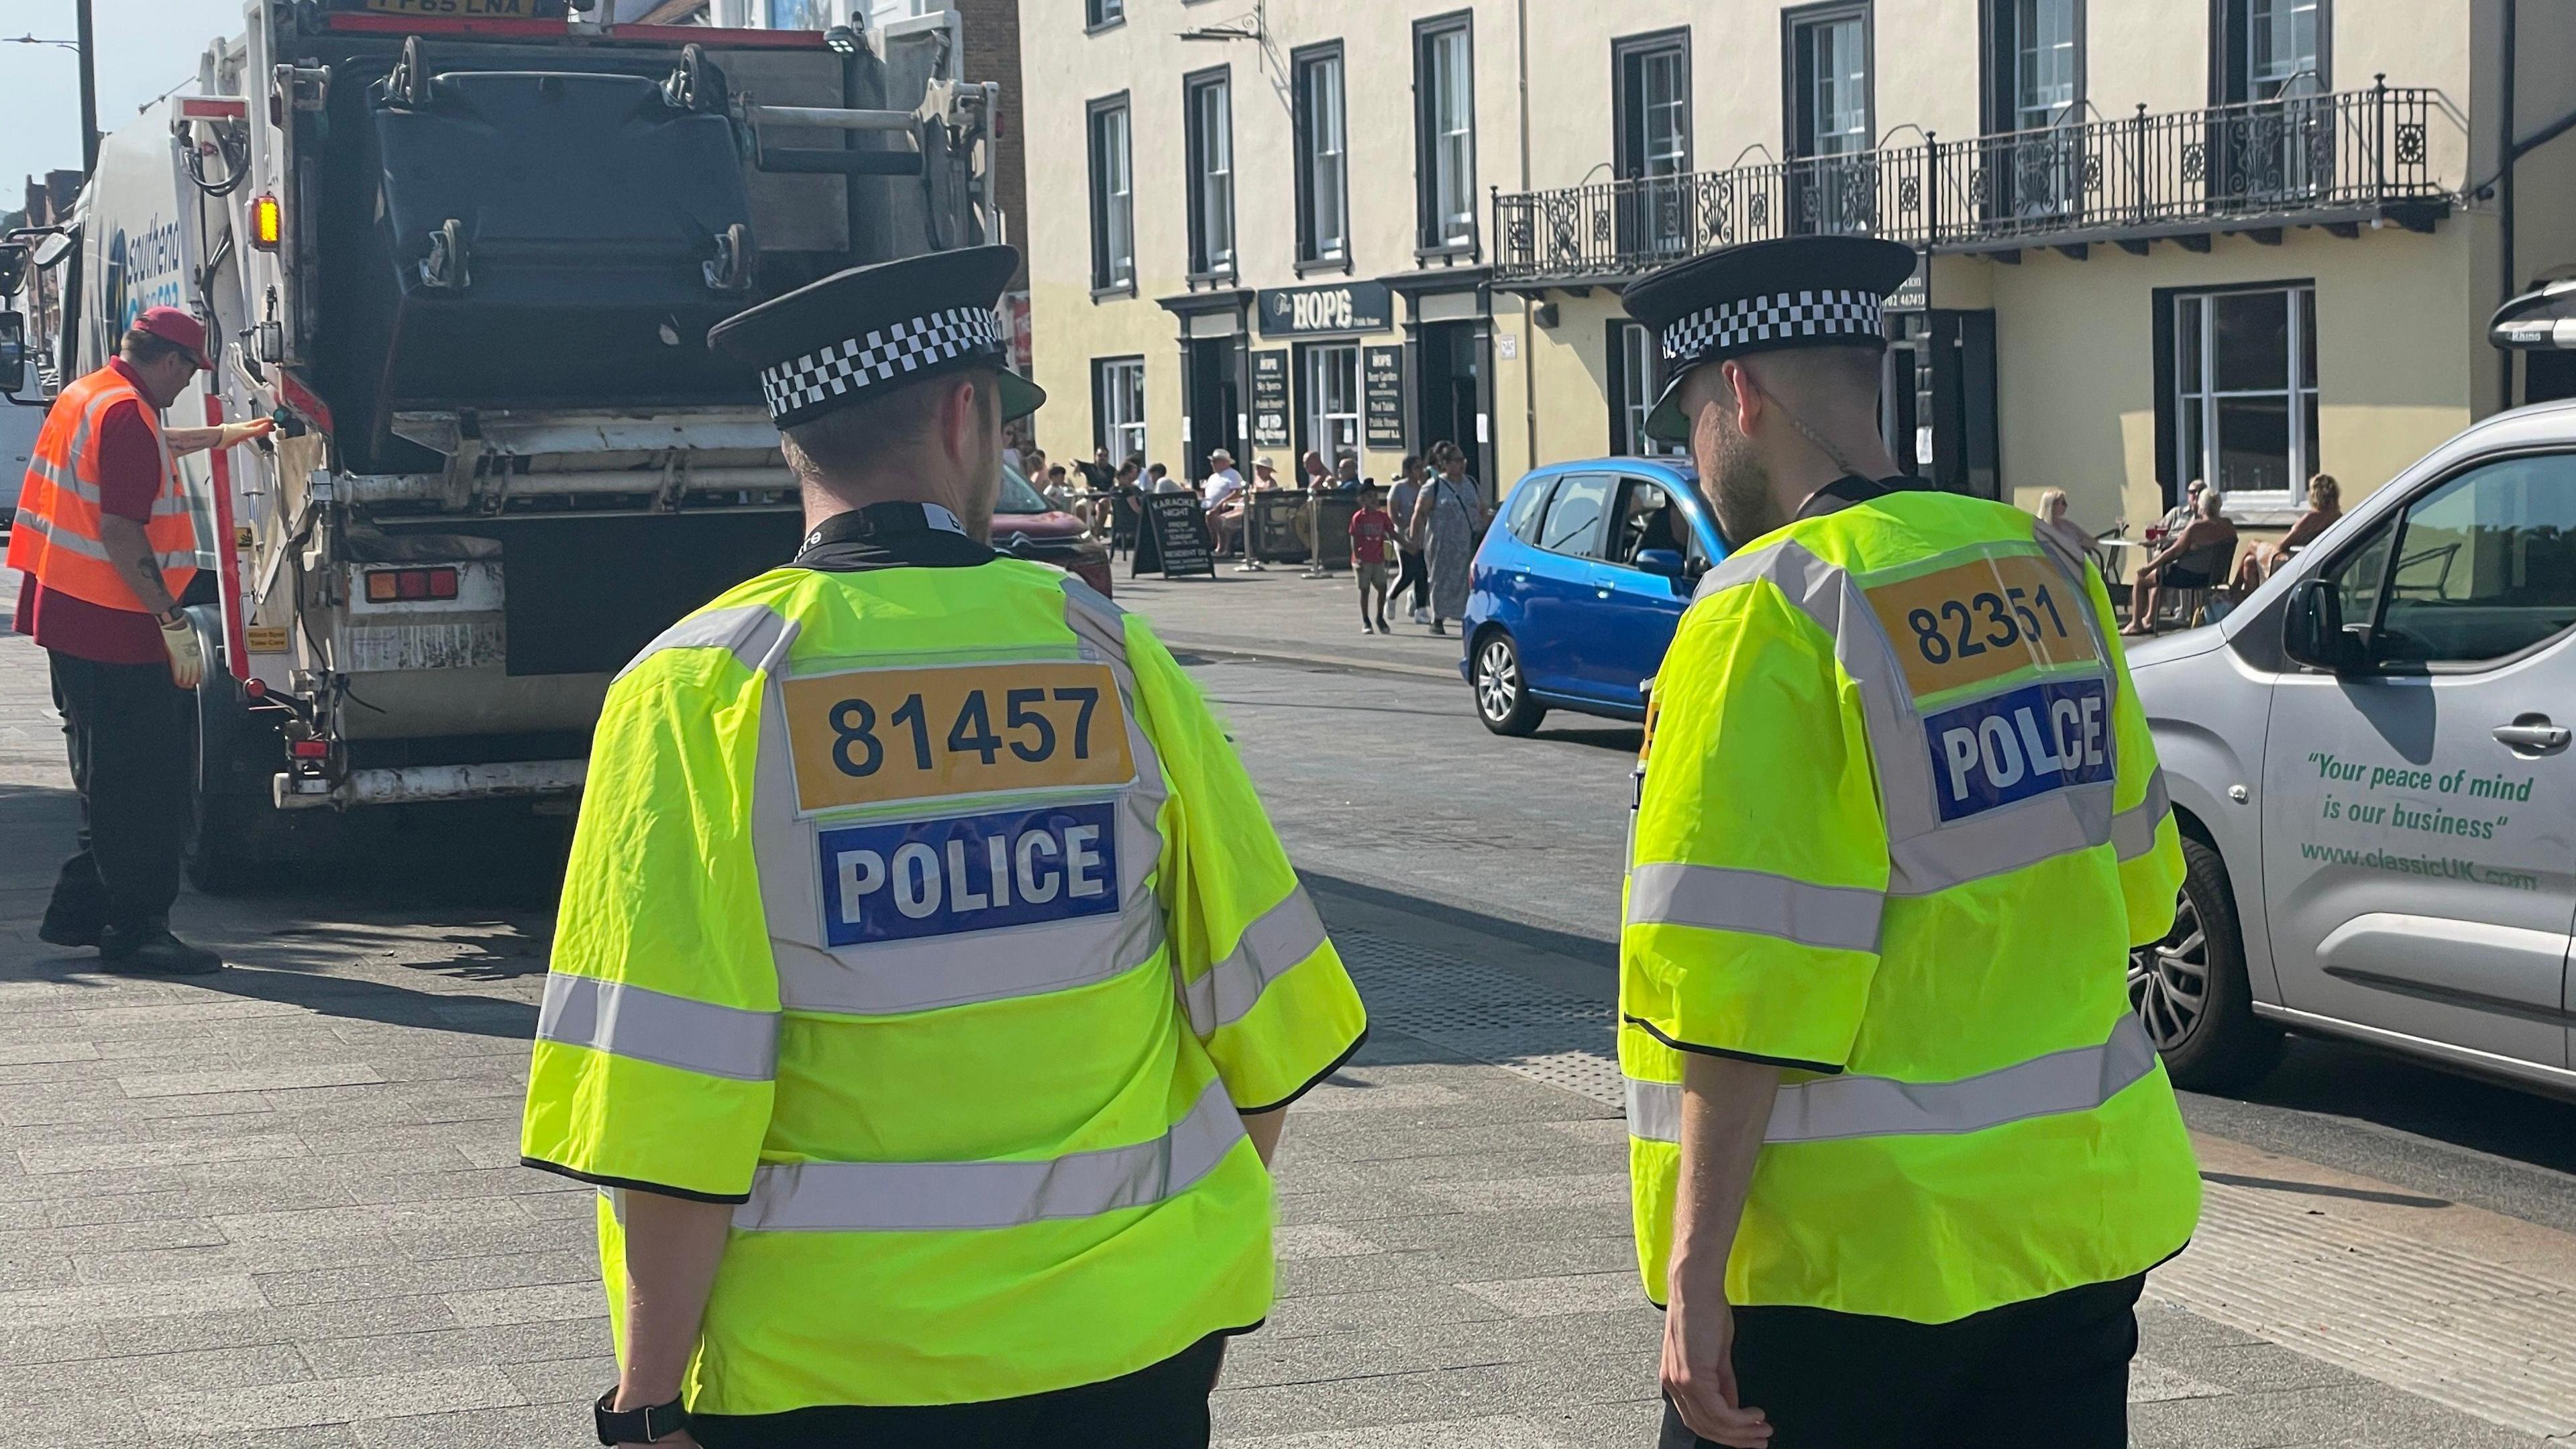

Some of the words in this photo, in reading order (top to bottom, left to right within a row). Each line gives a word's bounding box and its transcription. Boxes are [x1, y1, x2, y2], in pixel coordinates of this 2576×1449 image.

[466, 0, 521, 13] LNA
[1292, 288, 1353, 329] HOPE
[1900, 293, 1925, 306] 467413
[1152, 498, 1195, 509] KARAOKE
[1163, 507, 1189, 517] NIGHT
[1909, 584, 2068, 665] 82351
[828, 687, 1099, 777] 81457
[1942, 697, 2104, 801] POLCE
[2370, 767, 2432, 790] peace
[2438, 769, 2466, 794] of
[2469, 773, 2534, 802] mind
[2322, 794, 2340, 818] is
[2348, 803, 2386, 824] our
[837, 824, 1104, 924] POLICE
[2301, 843, 2538, 891] www.classicUK.com
